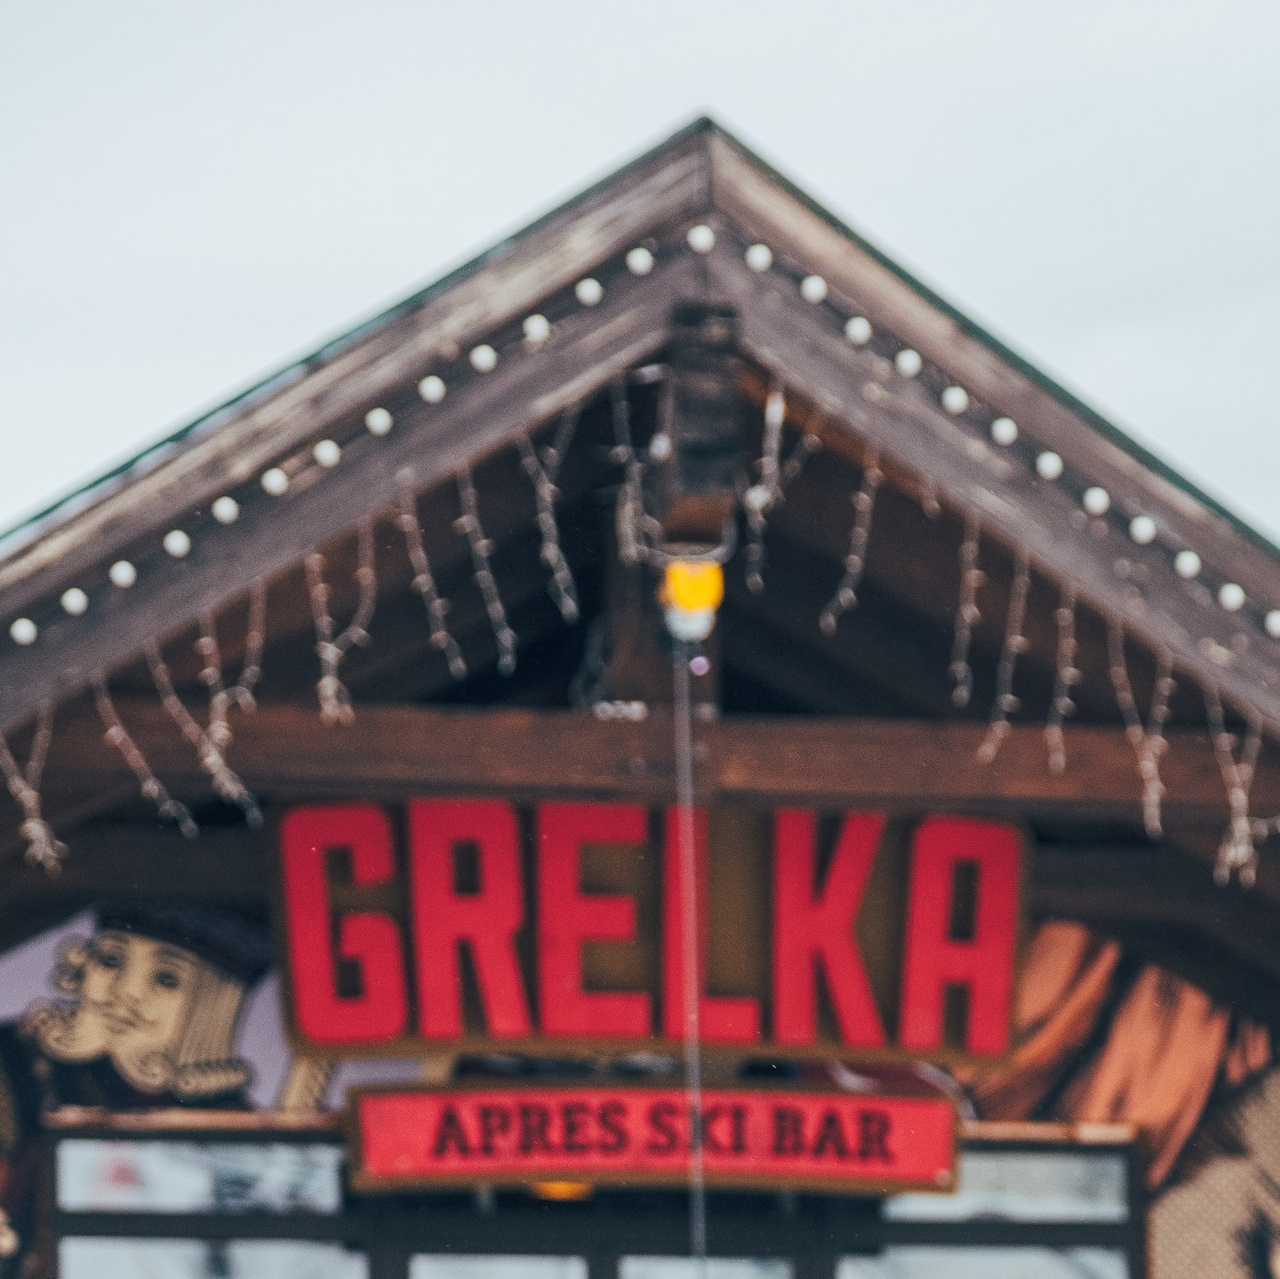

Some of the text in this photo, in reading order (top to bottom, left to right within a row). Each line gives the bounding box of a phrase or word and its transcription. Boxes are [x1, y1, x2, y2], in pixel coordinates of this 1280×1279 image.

[280, 798, 1023, 1055] GRELKA
[432, 1103, 894, 1163] APRES SKI BAR
